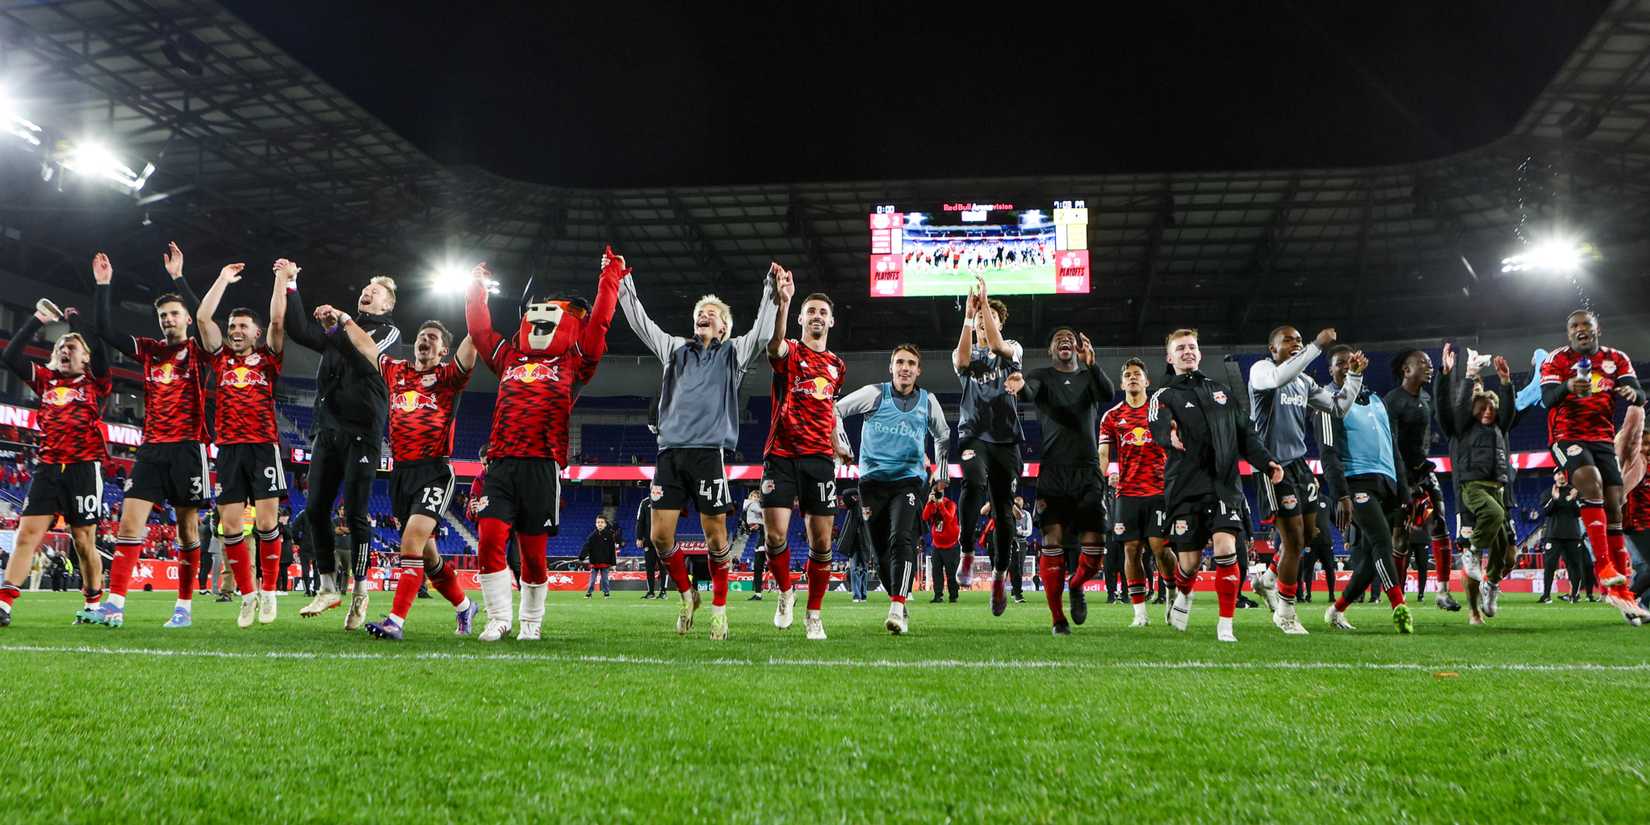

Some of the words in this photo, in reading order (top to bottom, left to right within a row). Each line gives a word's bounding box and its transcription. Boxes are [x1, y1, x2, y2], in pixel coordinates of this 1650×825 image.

[875, 271, 900, 280] PLAYOFFS
[1059, 267, 1085, 276] PLAYOFFS
[263, 466, 276, 485] 9
[190, 476, 202, 494] 3
[699, 478, 724, 500] 47
[817, 480, 836, 502] 12
[76, 494, 97, 513] 10
[421, 487, 445, 505] 13
